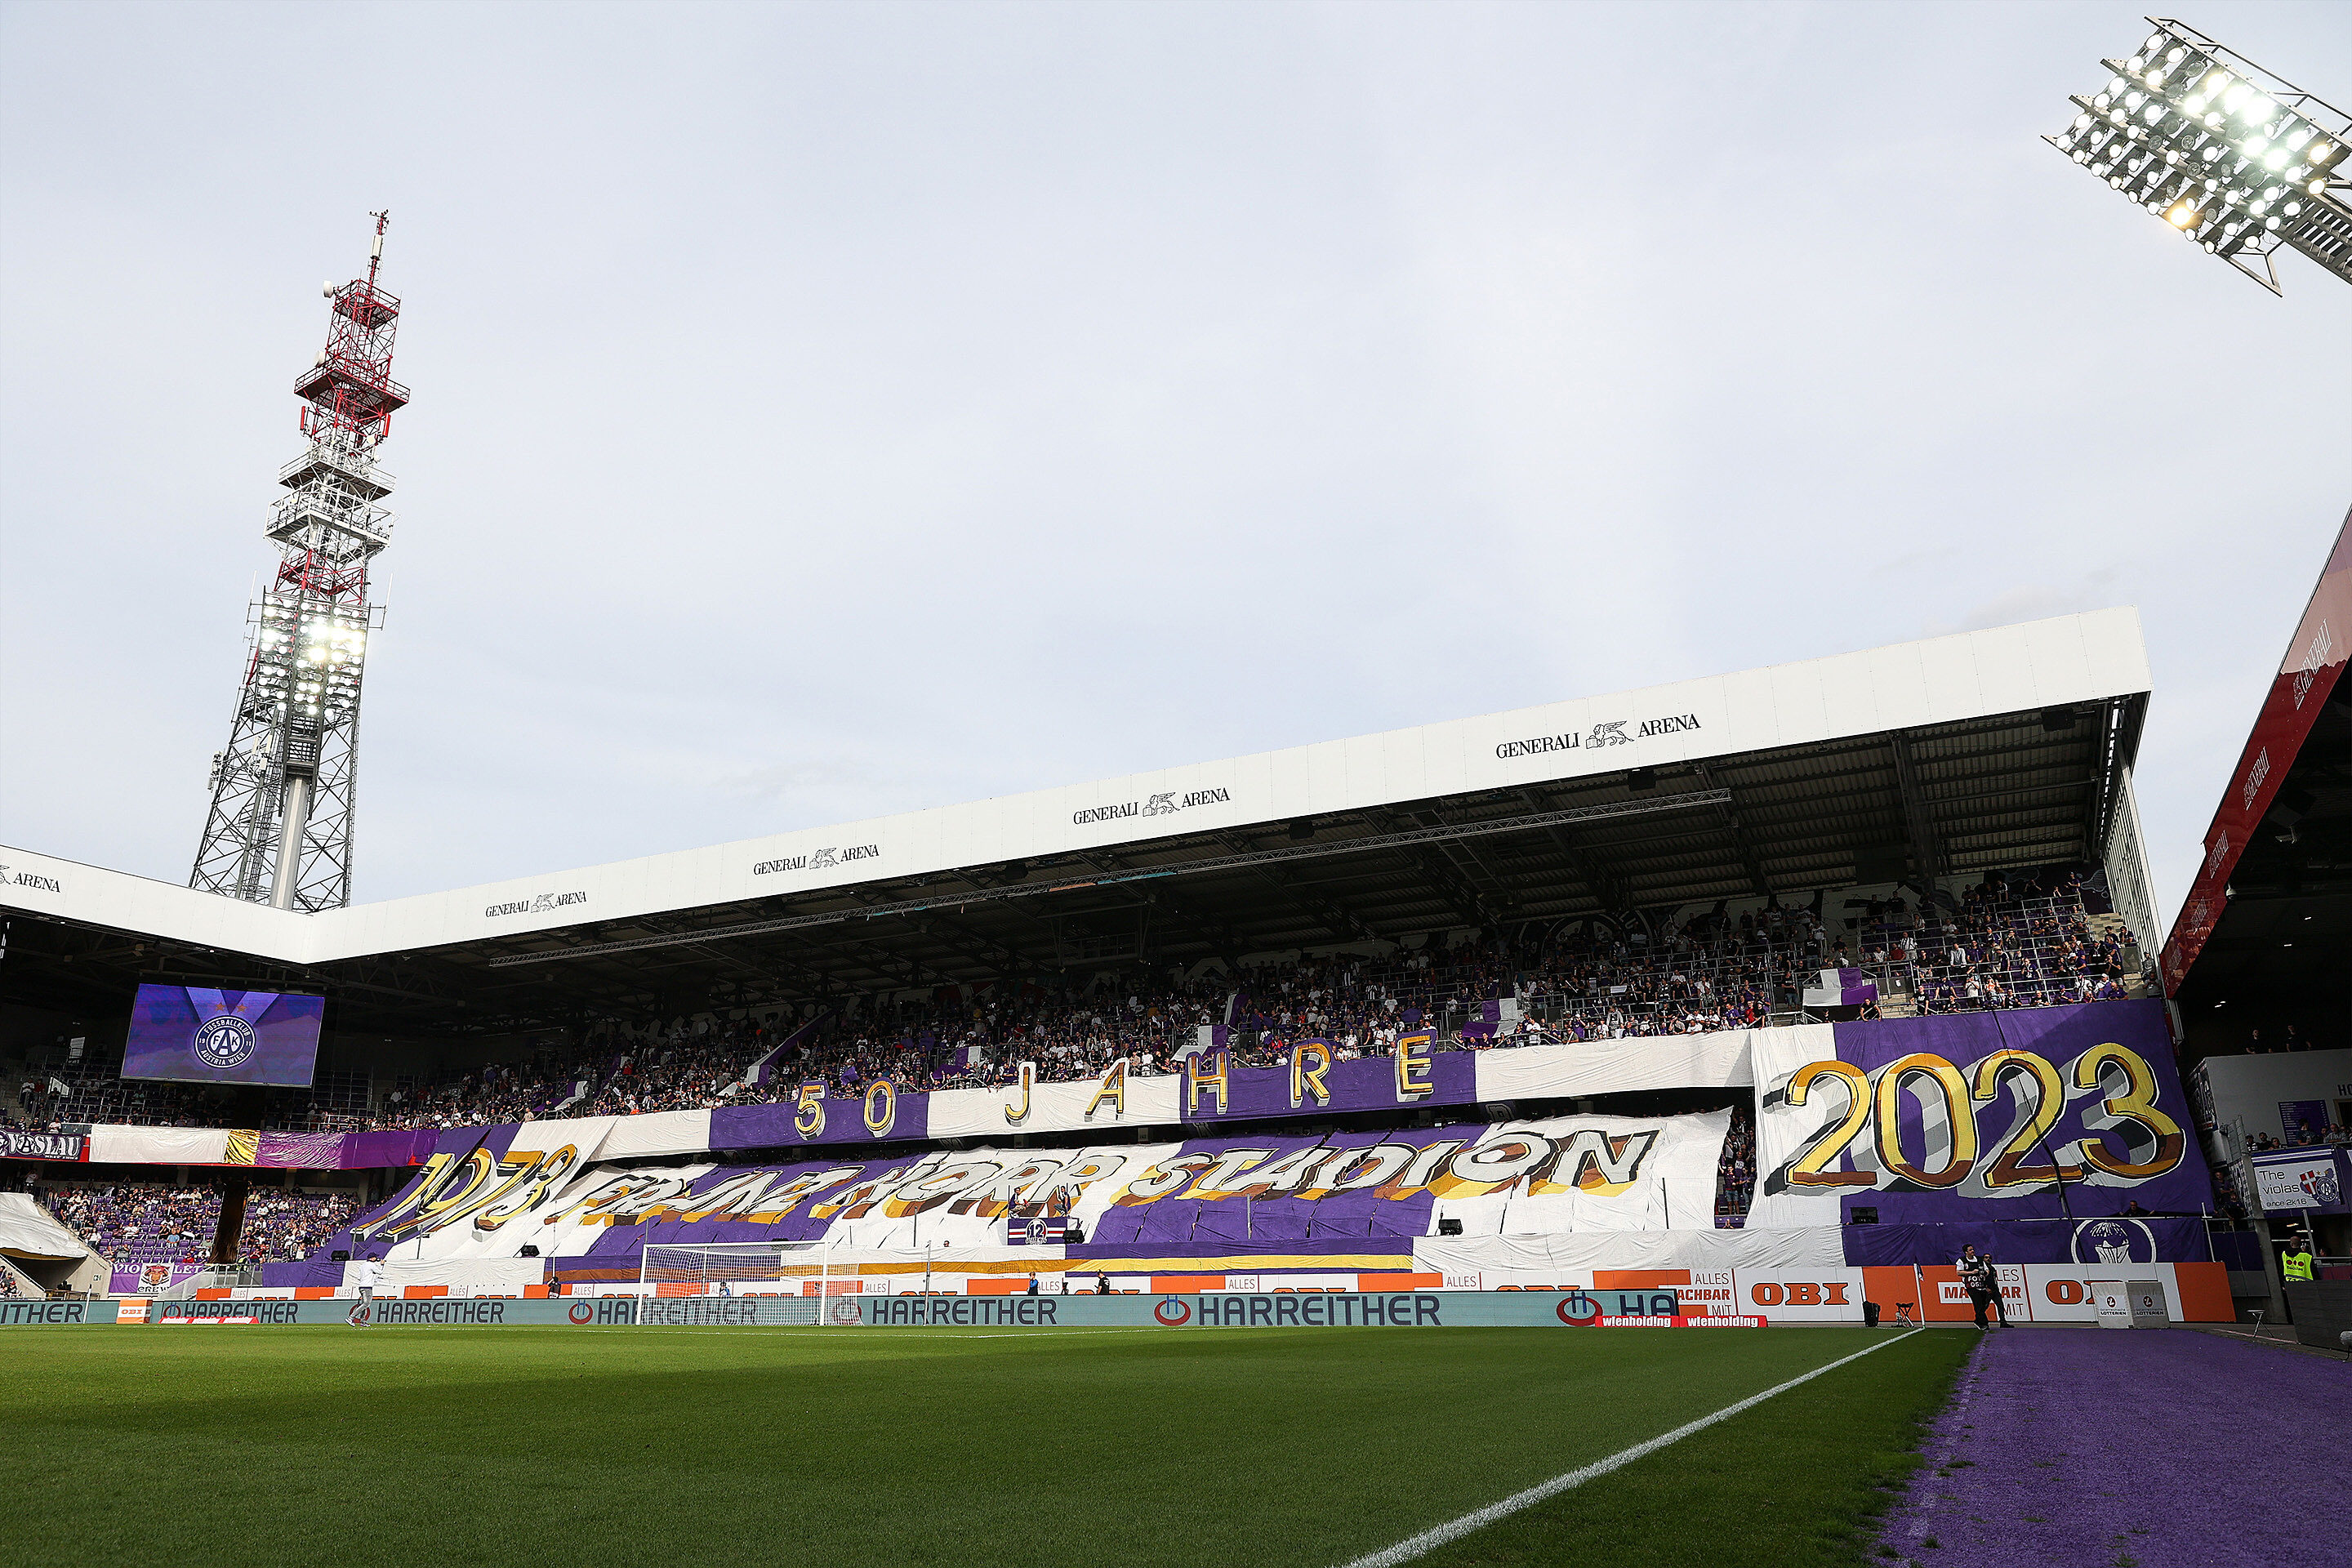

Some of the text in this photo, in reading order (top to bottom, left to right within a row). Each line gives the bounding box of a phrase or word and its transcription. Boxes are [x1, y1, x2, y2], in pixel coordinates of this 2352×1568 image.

[2300, 618, 2332, 693] GENERALI
[1496, 714, 1701, 759] GENERALI ARENA
[1073, 787, 1231, 825] GENERALI ARENA
[754, 844, 880, 875] GENERALI ARENA
[13, 872, 60, 893] ARENA
[485, 891, 587, 917] GENERALI ARENA
[203, 1019, 251, 1036] FUSSBALLKLUB
[201, 1049, 246, 1065] AUSTRIA WIEN
[793, 1034, 1436, 1139] 50 JAHRE
[1779, 1041, 2187, 1191] 2023
[1112, 1129, 1661, 1209] STADION
[2259, 1170, 2285, 1181] The
[2263, 1183, 2301, 1195] violas
[1029, 1223, 1043, 1237] 12
[1446, 1276, 1477, 1288] ALLES
[1695, 1272, 1730, 1285] ALLES
[1996, 1268, 2020, 1282] LES
[450, 1287, 466, 1297] ALLES
[573, 1285, 592, 1296] ALLES
[864, 1282, 887, 1294] ALLES
[1228, 1278, 1255, 1290] ALLES
[1944, 1286, 2022, 1299] MAAR
[232, 1290, 246, 1299] ALLES
[336, 1289, 351, 1298] ALLES
[1677, 1289, 1731, 1301] ACHBAR
[1751, 1282, 1850, 1306] OBI
[1, 1303, 83, 1324] ITHER
[185, 1302, 299, 1324] HARREITHER
[376, 1302, 505, 1324] HARREITHER
[871, 1299, 1058, 1325] HARREITHER
[1198, 1295, 1442, 1326] HARREITHER
[1619, 1294, 1676, 1316] HA
[1712, 1304, 1731, 1316] MIT
